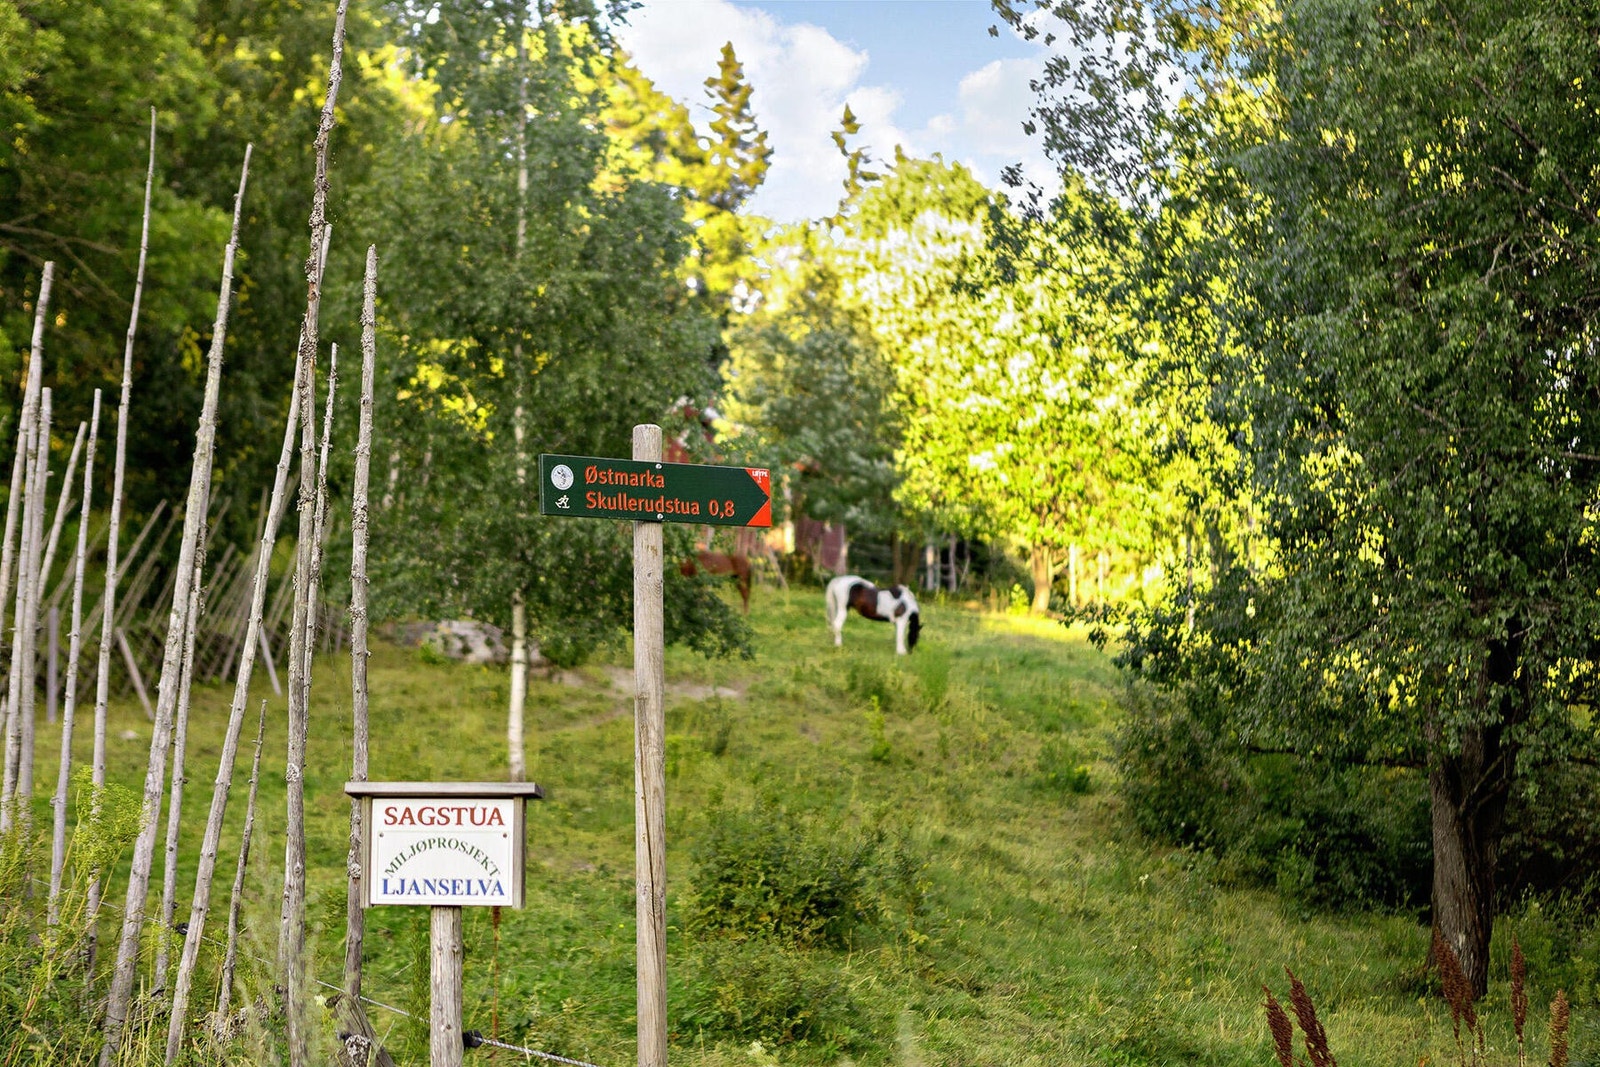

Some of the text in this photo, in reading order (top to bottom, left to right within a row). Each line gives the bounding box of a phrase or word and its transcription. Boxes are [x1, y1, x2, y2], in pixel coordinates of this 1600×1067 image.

[585, 465, 665, 488] Østmarka
[586, 491, 735, 518] Skullerudstua 0,8
[384, 806, 505, 826] SAGSTUA
[384, 837, 500, 878] MILJØPROSJEKT
[382, 878, 505, 896] LJANSELVA
